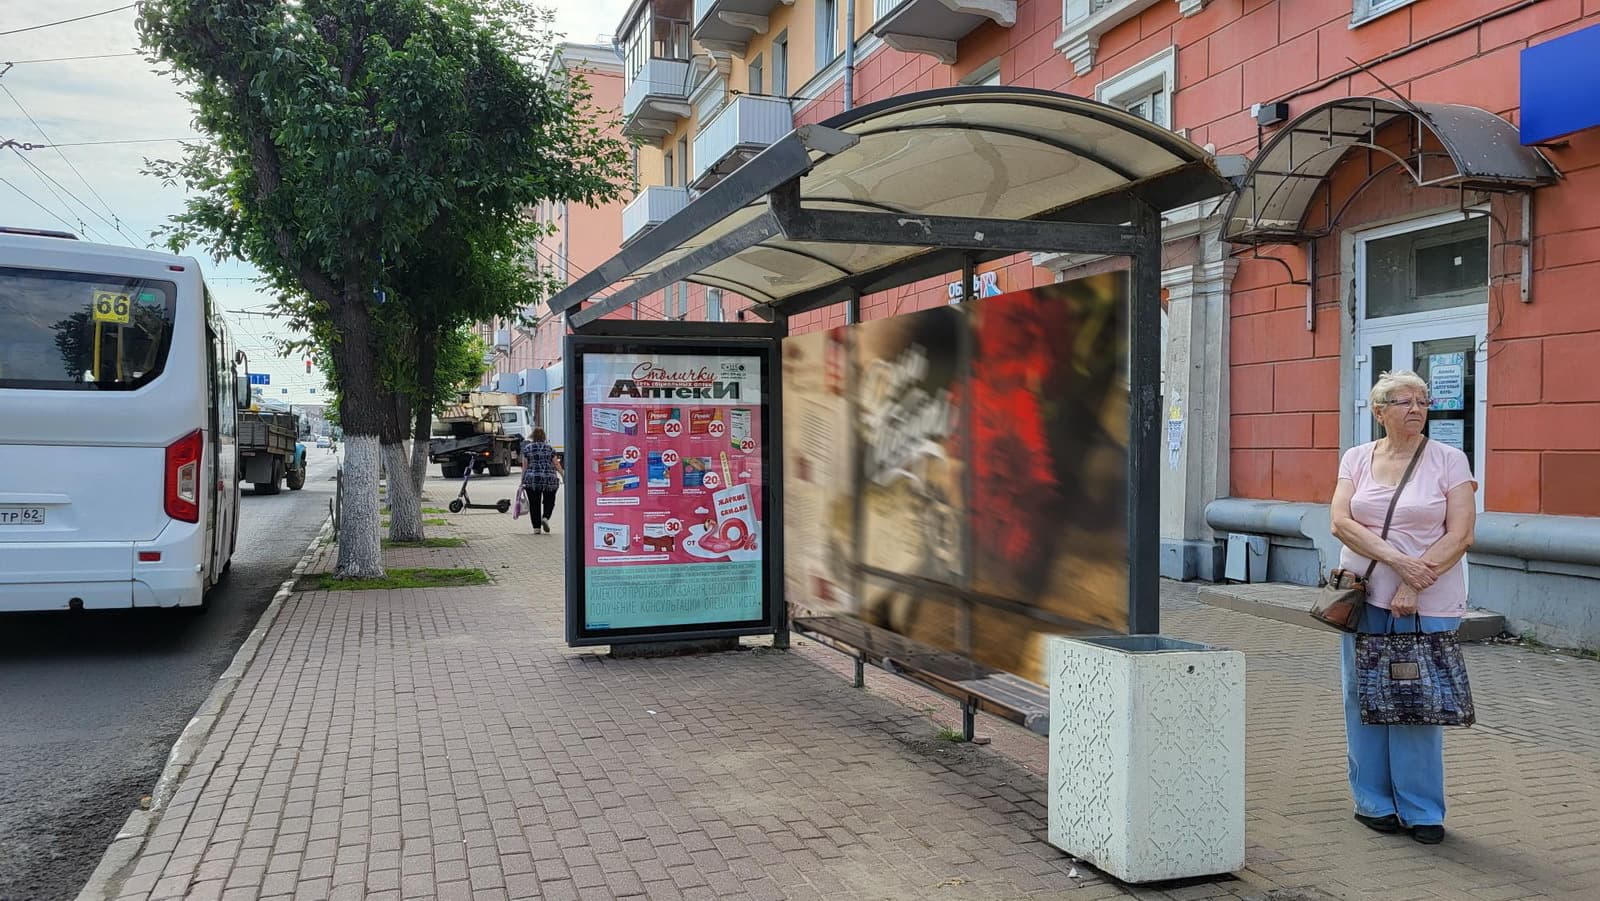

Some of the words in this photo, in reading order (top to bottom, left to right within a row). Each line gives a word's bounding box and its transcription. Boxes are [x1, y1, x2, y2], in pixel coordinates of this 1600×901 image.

[97, 294, 128, 315] 66
[632, 362, 718, 380] Столички
[622, 413, 637, 423] 20
[666, 423, 680, 432] 20
[709, 424, 723, 433] 20
[742, 441, 753, 449] 20
[625, 450, 638, 459] 50
[663, 453, 677, 462] 20
[718, 494, 746, 506] ЖАРКИЕ
[24, 509, 39, 519] 62
[721, 504, 748, 516] СКИДКИ
[667, 522, 680, 531] 30
